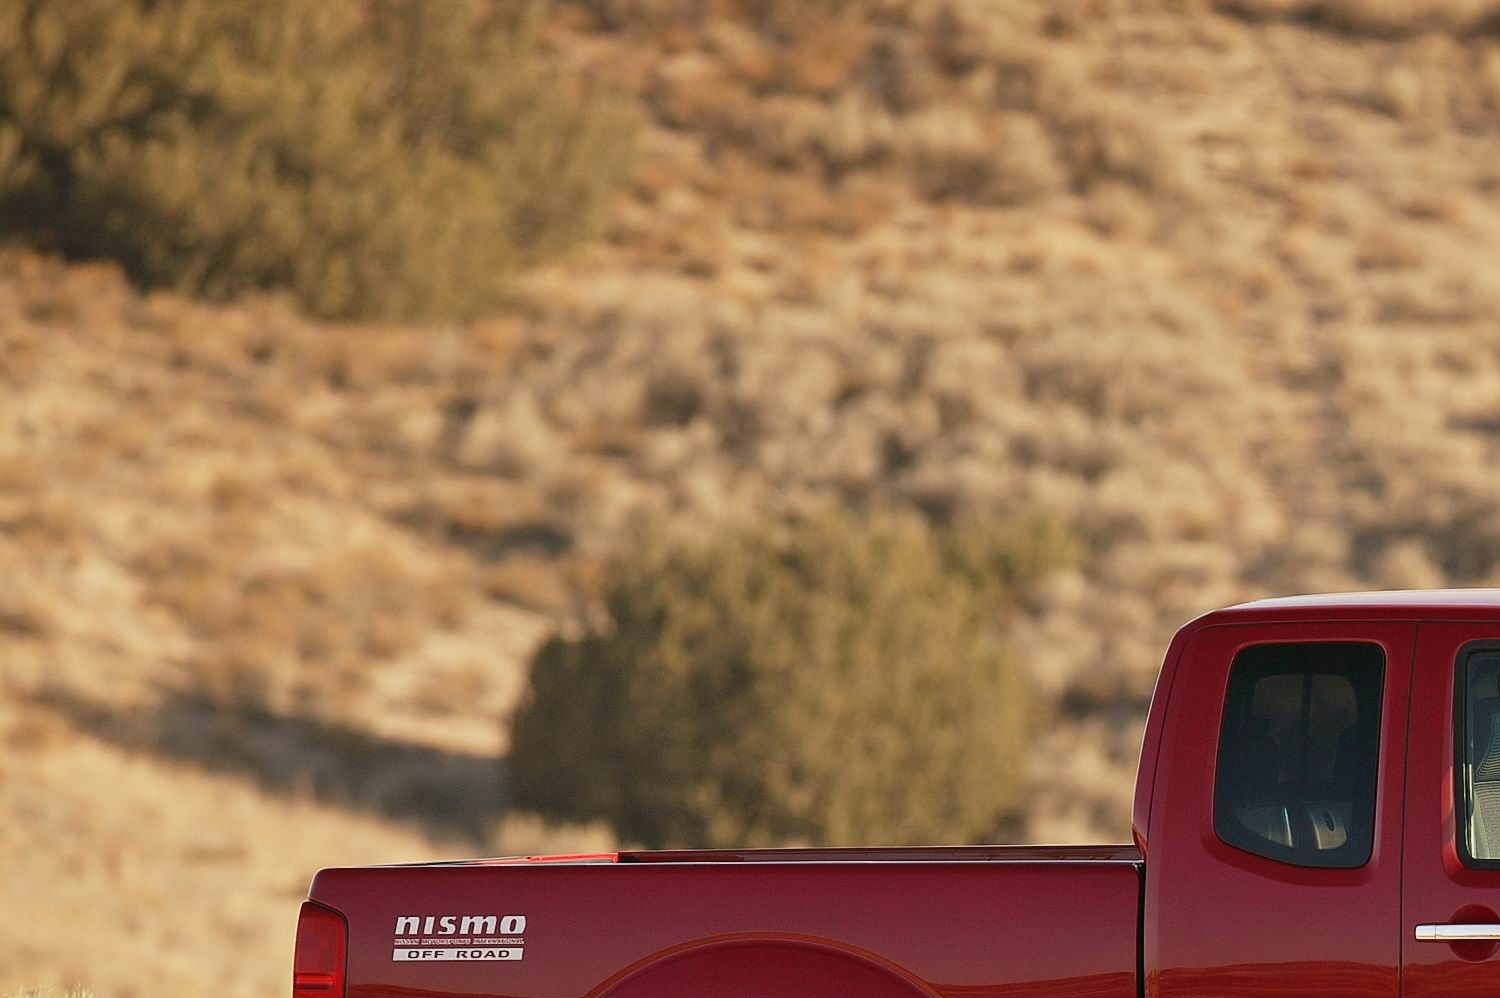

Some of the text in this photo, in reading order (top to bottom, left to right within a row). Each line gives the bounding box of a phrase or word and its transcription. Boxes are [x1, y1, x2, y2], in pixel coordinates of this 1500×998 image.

[395, 915, 527, 935] nismo
[407, 950, 510, 959] OFF ROAD
